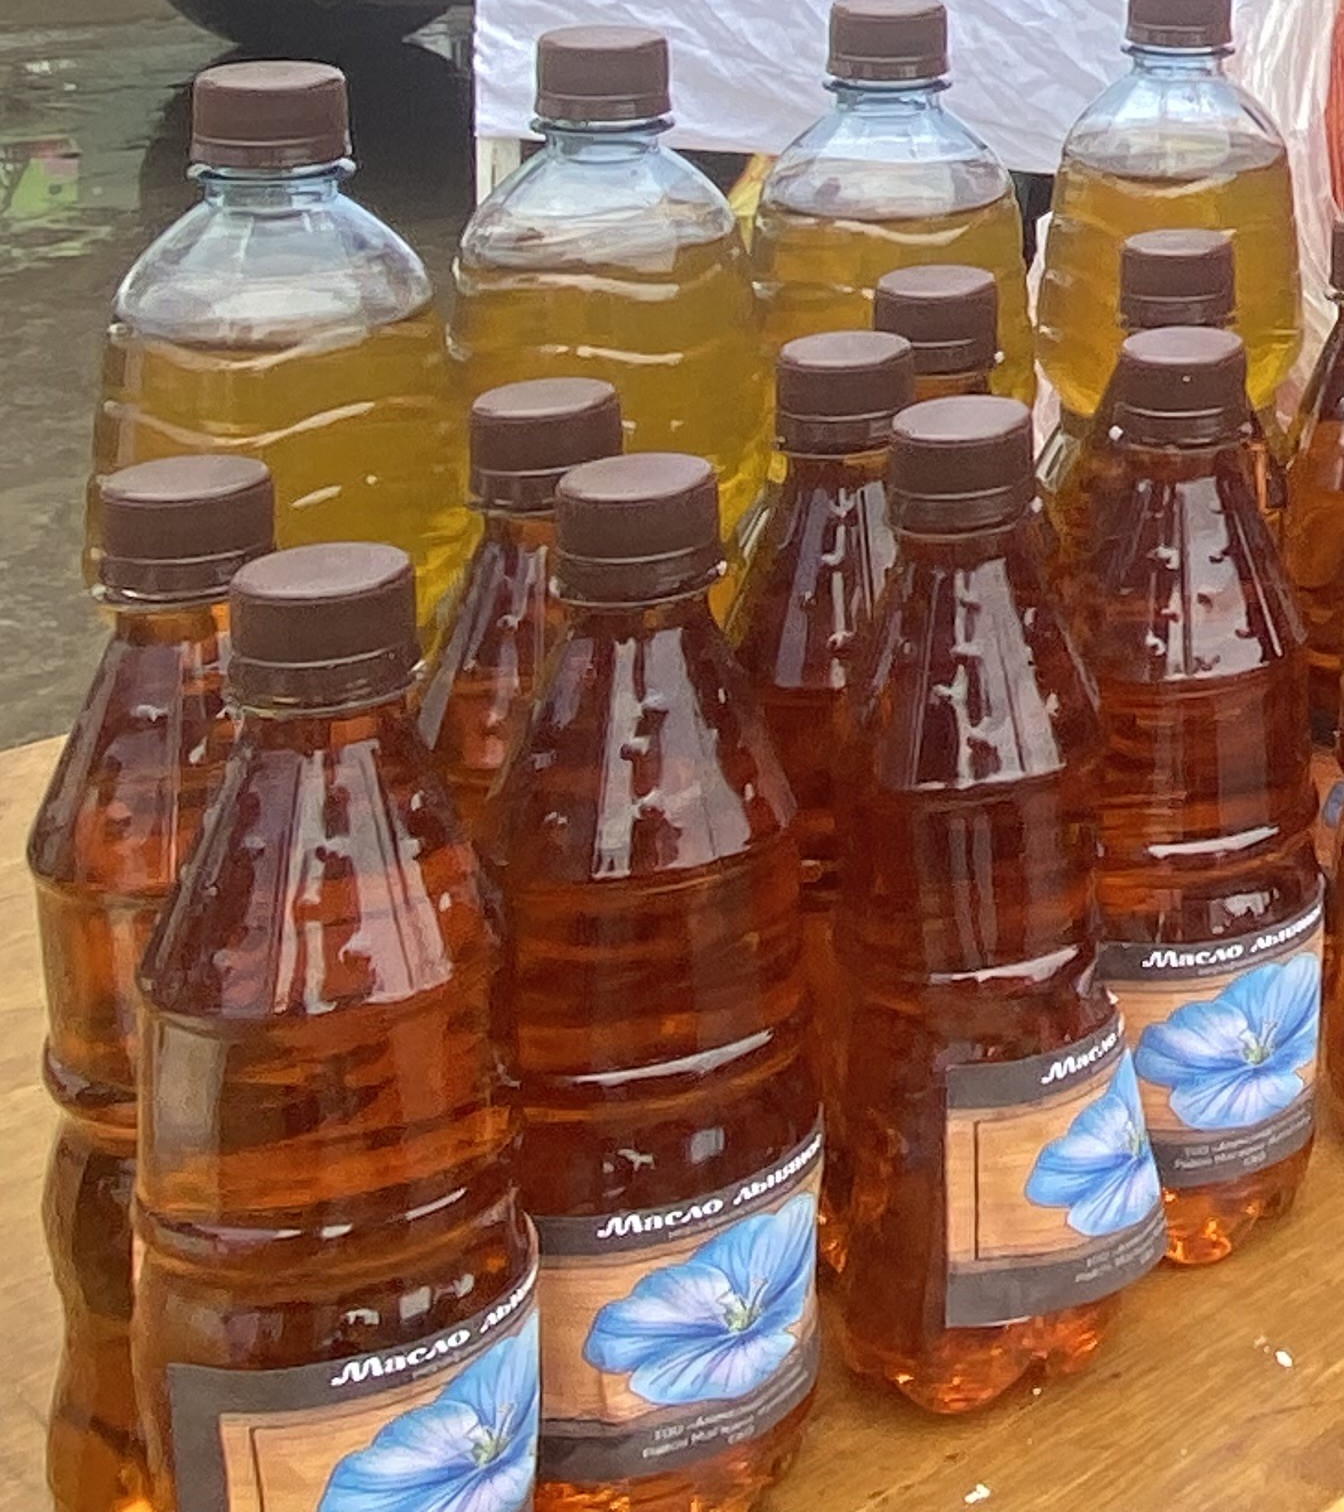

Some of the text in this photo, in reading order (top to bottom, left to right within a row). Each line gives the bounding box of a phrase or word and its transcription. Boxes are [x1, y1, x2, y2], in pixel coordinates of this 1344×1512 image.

[1142, 943, 1244, 969] Масло
[1040, 1032, 1117, 1084] Масло
[597, 1198, 724, 1239] Масло
[331, 1329, 471, 1386] Масло
